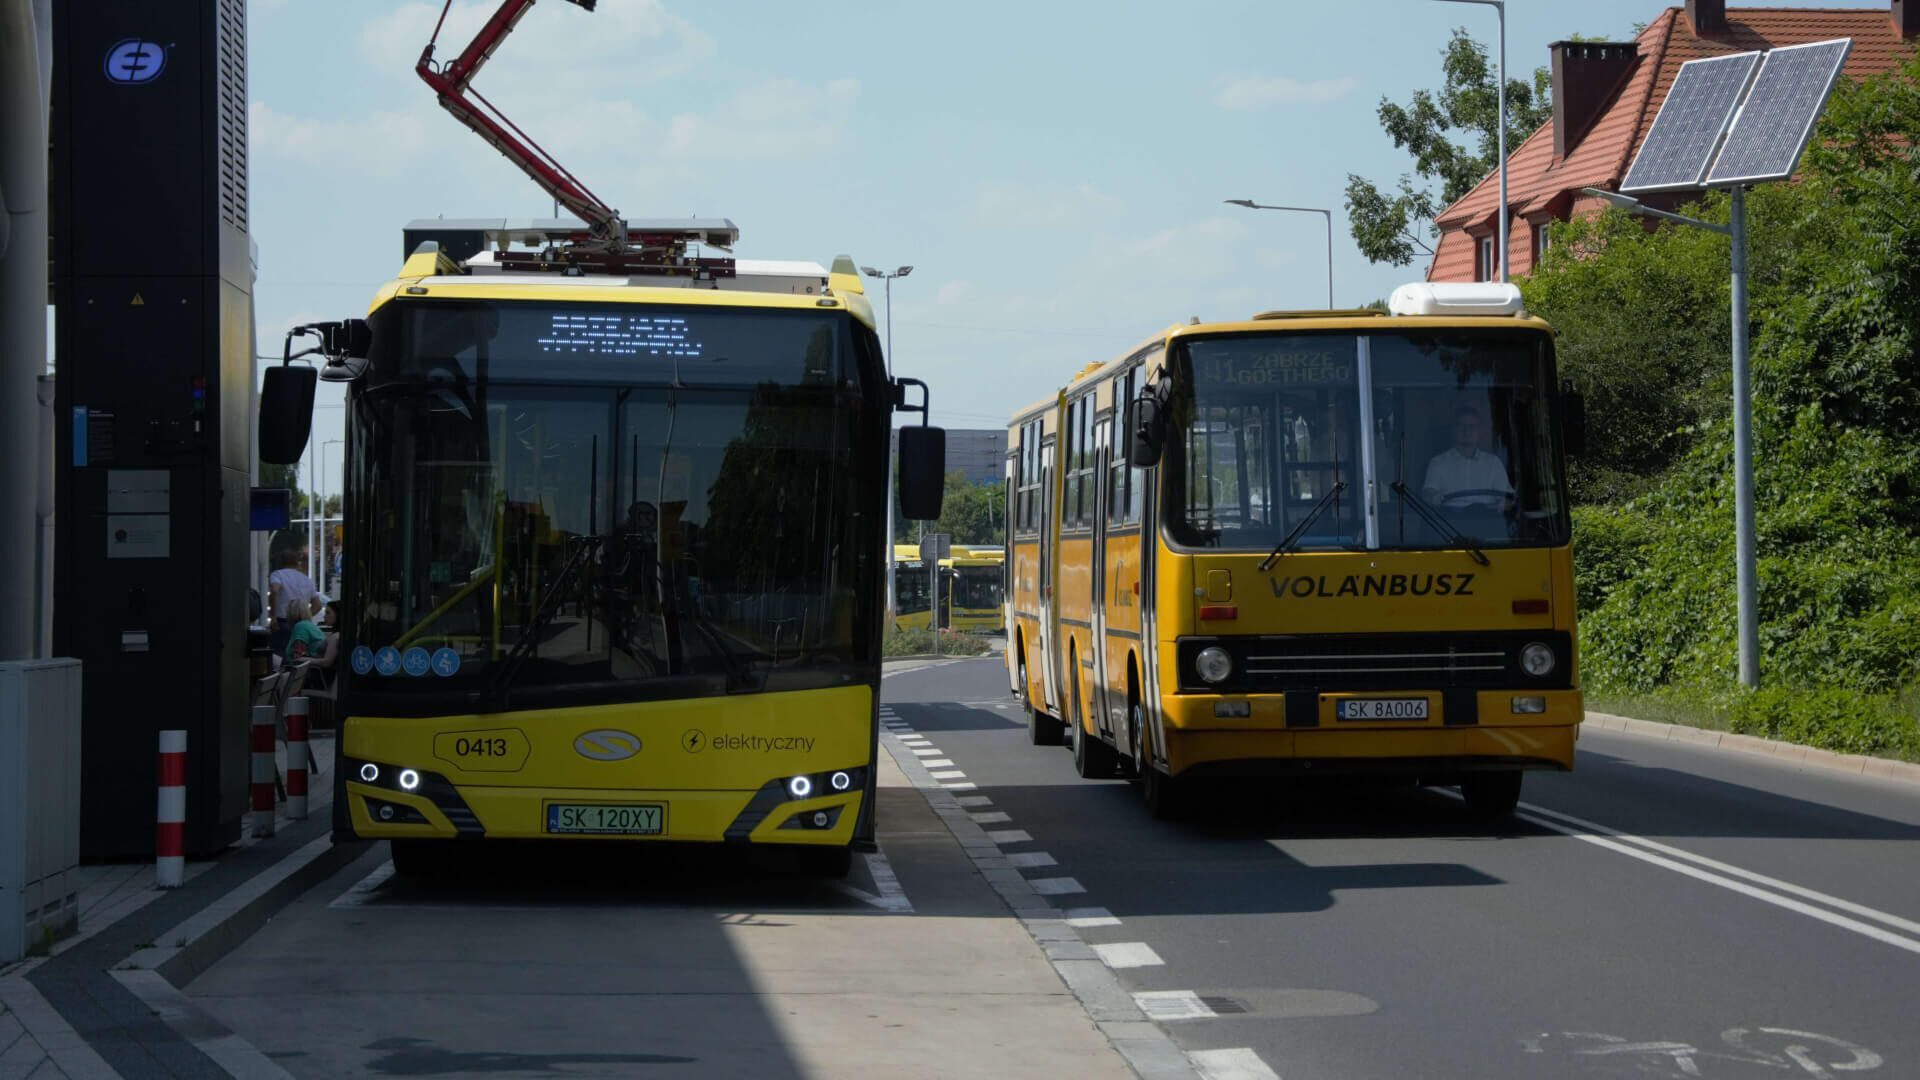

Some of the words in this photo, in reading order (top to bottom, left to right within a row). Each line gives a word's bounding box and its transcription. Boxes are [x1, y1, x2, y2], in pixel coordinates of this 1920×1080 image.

[1252, 352, 1335, 368] ZABRZE
[1238, 366, 1349, 384] GOETHEGO
[1270, 573, 1476, 598] VOLÁNBUSZ
[1348, 701, 1368, 717] SK
[1375, 701, 1423, 717] 8A006
[455, 737, 507, 758] 0413
[712, 732, 816, 754] elektryczny
[562, 808, 587, 827] SK
[597, 808, 655, 828] 120XY
